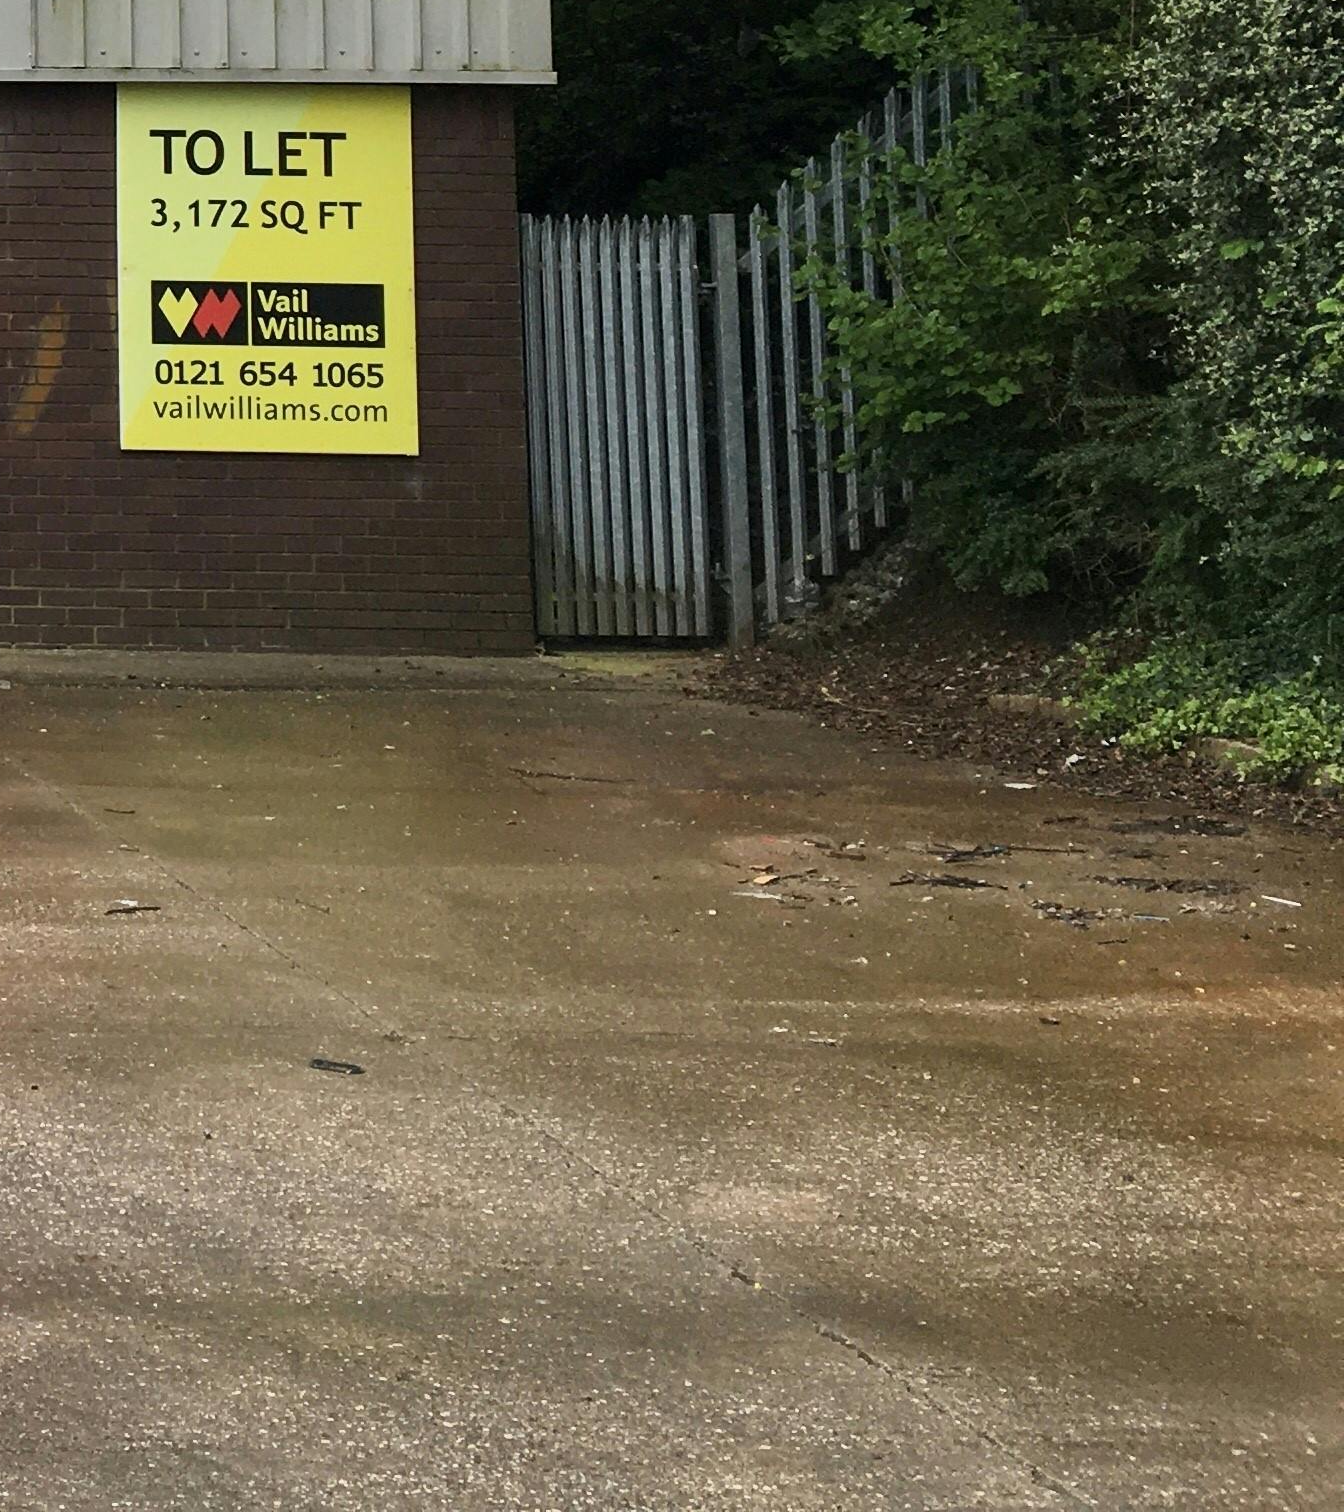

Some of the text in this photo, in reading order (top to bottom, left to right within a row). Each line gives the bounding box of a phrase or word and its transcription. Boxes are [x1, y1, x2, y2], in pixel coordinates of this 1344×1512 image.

[149, 129, 347, 177] TO LET
[150, 198, 362, 234] 3,172 SQ FT
[257, 289, 308, 313] Vail
[257, 317, 379, 342] Williams
[154, 360, 385, 388] 0121 654 1065
[153, 395, 388, 423] vailwilliams.com
